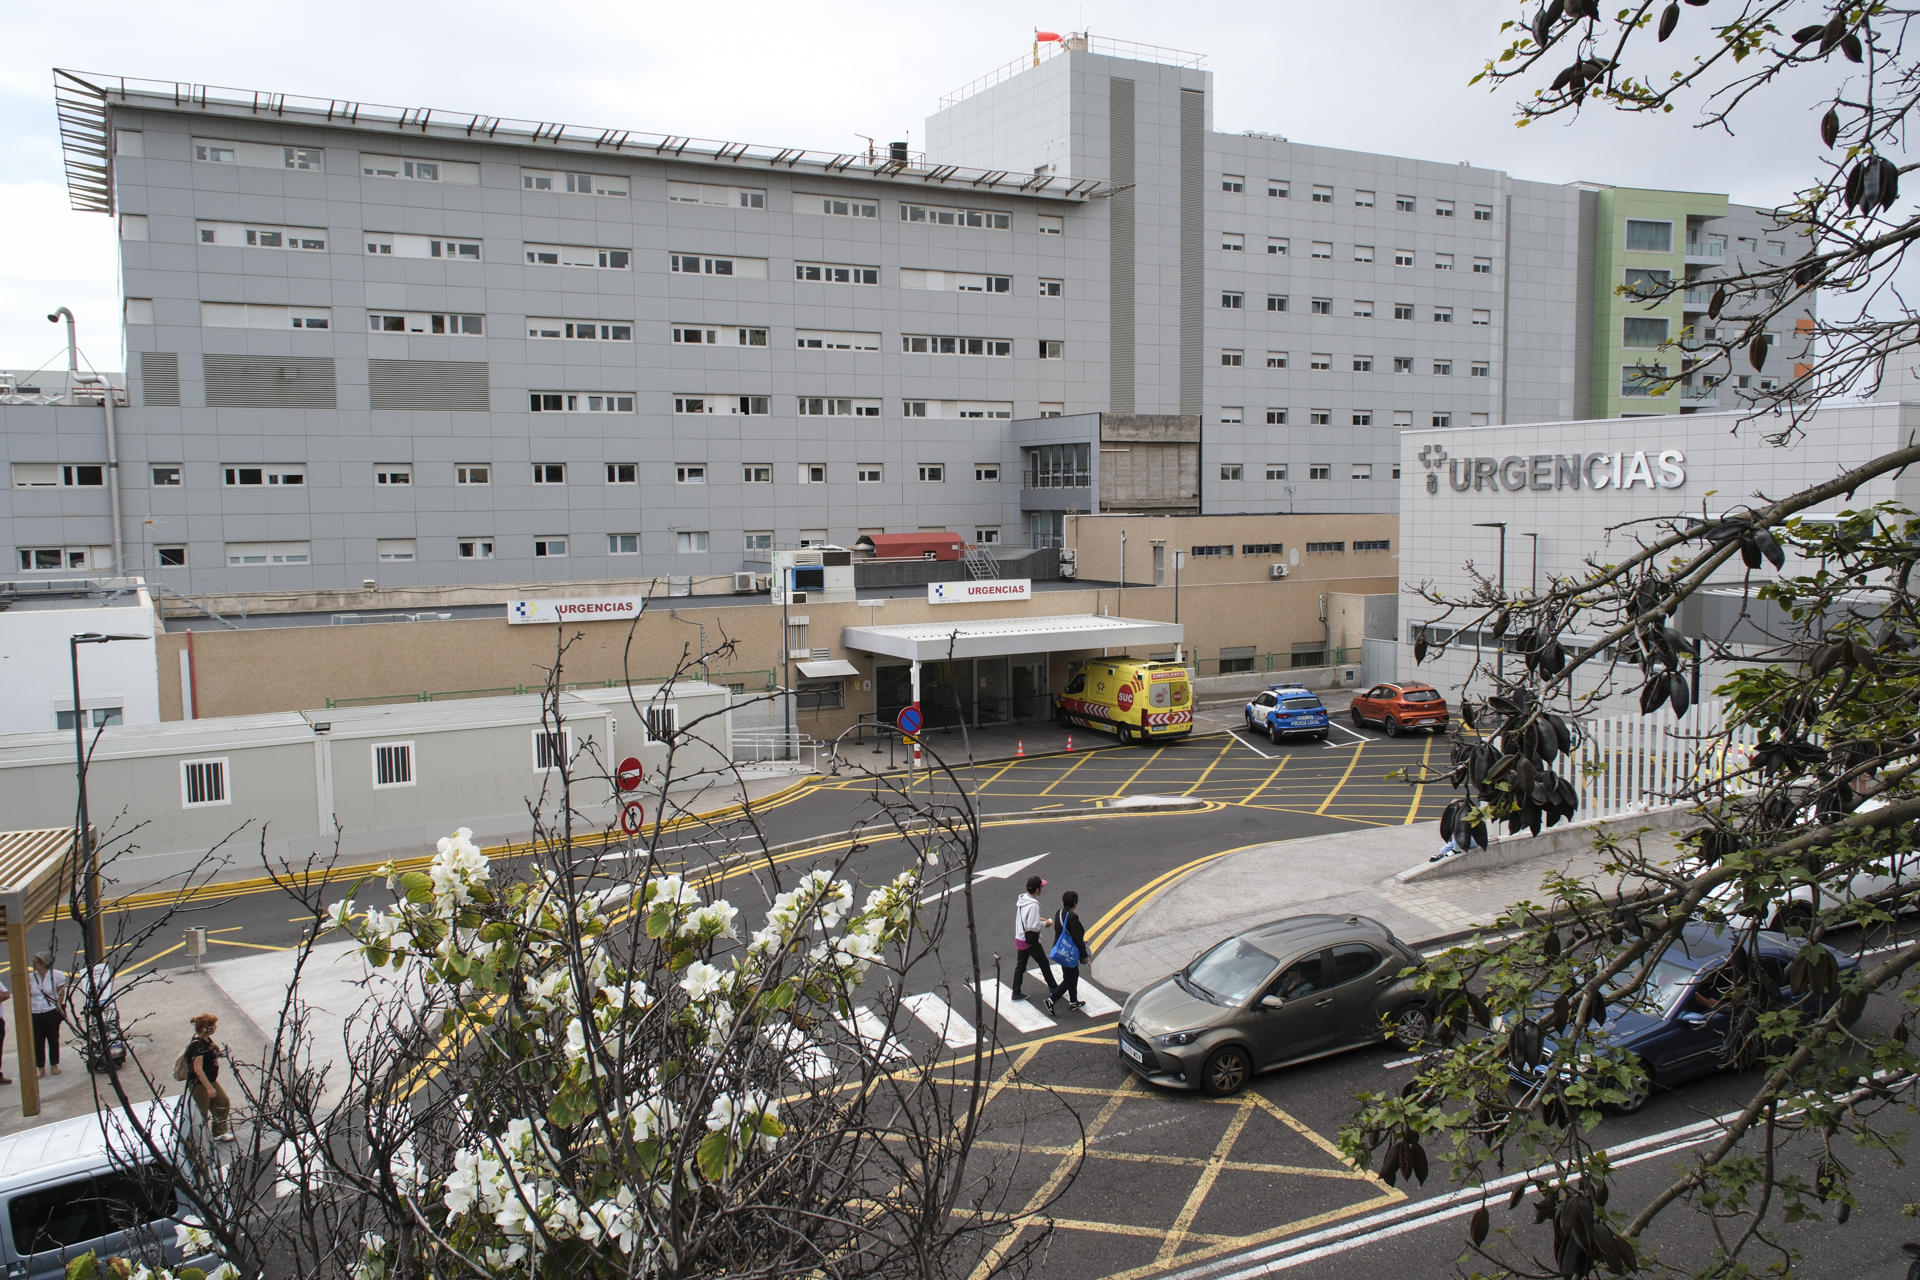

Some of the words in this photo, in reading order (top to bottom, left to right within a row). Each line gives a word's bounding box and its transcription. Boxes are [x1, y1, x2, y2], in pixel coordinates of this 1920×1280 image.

[1449, 449, 1686, 492] URGENCIAS
[967, 585, 1025, 595] URGENCIAS
[559, 602, 634, 614] URGENCIAS
[1118, 692, 1133, 704] SUC
